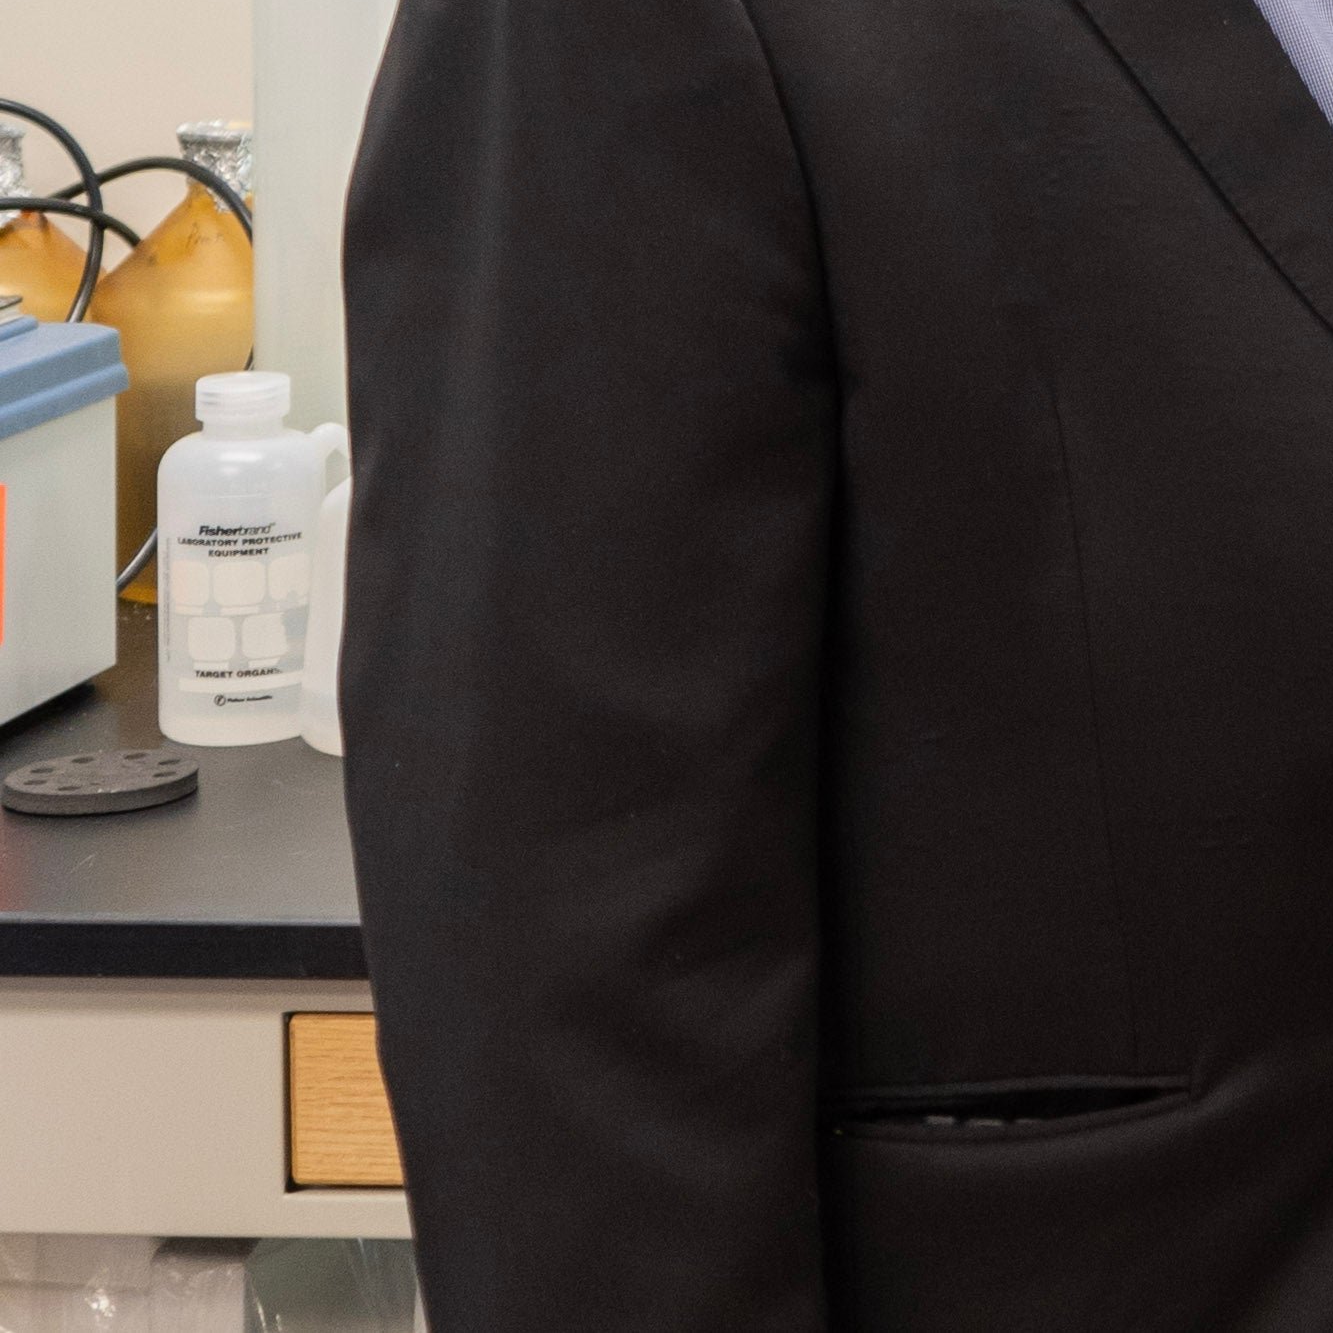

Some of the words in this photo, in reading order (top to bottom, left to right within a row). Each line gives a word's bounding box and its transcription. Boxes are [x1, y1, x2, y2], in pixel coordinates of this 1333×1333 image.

[177, 536, 238, 546] LABORATORY
[242, 532, 303, 546] PROTECTIVE
[208, 547, 269, 558] EQUIPMENT
[195, 670, 233, 679] TARGET
